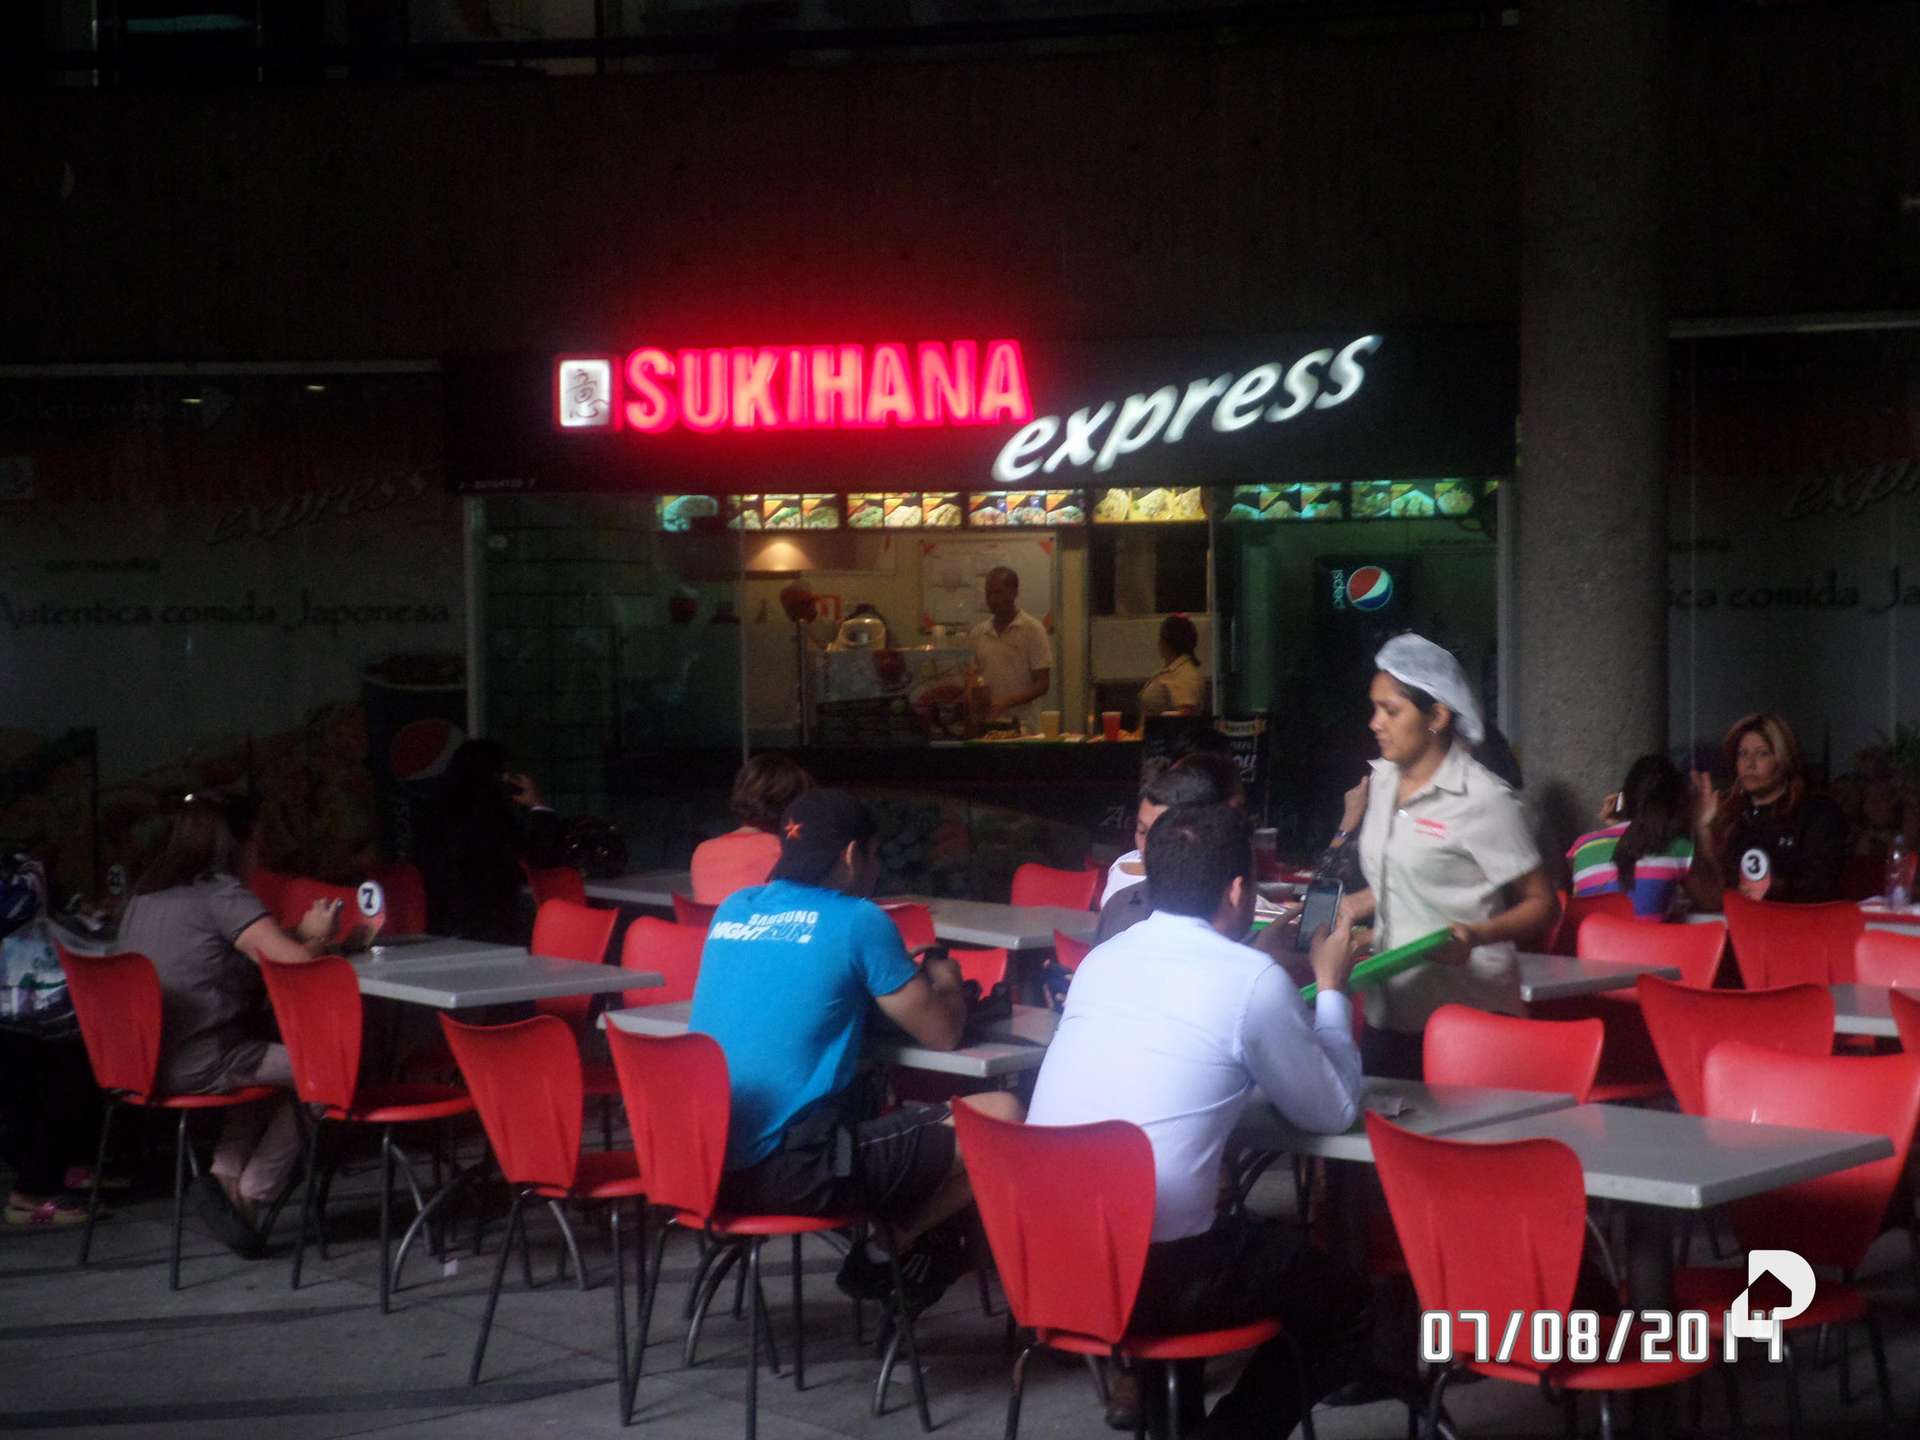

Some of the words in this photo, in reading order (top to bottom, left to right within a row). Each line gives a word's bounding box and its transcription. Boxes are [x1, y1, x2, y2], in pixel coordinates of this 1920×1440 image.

[625, 341, 1034, 432] SUKIHANA
[991, 334, 1383, 482] express
[1331, 569, 1345, 609] pepsi
[1727, 568, 1858, 609] comida
[1747, 855, 1761, 875] 3
[362, 888, 374, 909] 7
[748, 910, 818, 926] SAMSUNG
